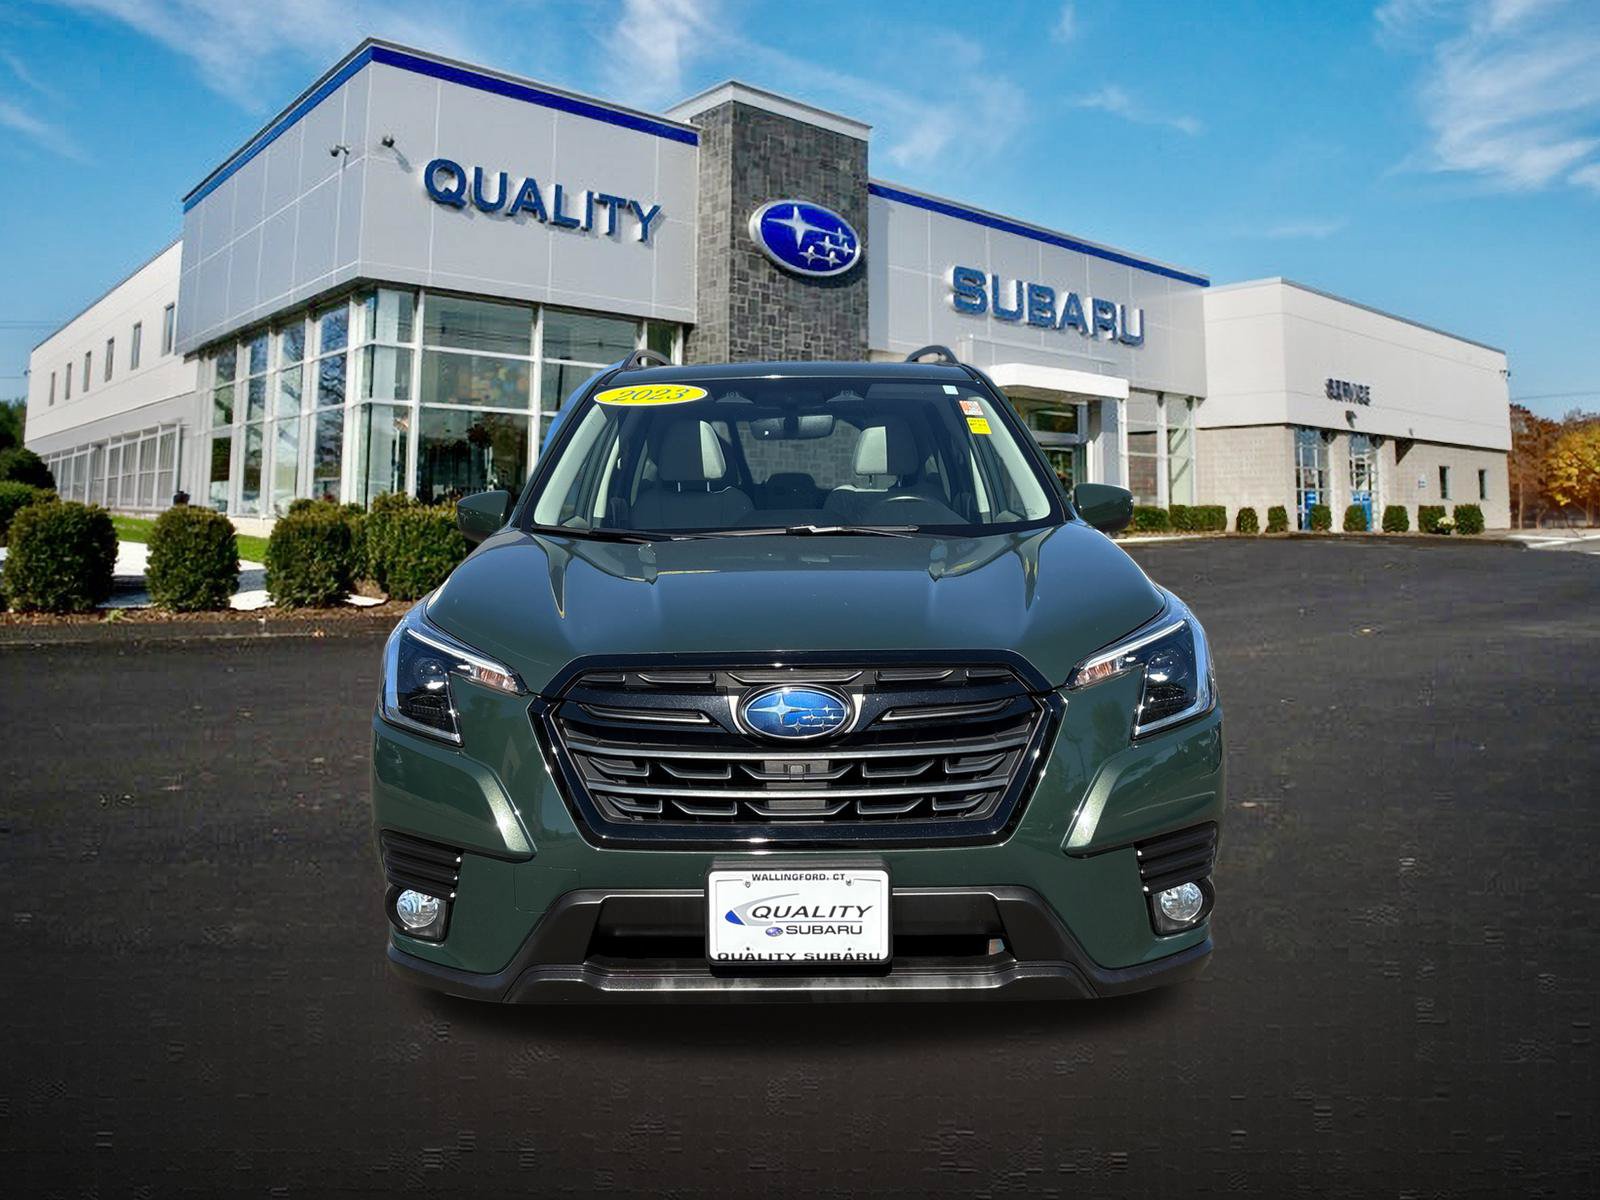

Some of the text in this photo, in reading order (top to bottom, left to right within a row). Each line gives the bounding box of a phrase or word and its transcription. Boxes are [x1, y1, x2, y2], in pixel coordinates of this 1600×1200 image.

[424, 158, 662, 243] QUALITY
[950, 266, 1144, 345] SUBARU
[611, 387, 690, 402] 2023
[752, 905, 872, 919] QUALITY
[786, 925, 862, 935] SUBARU
